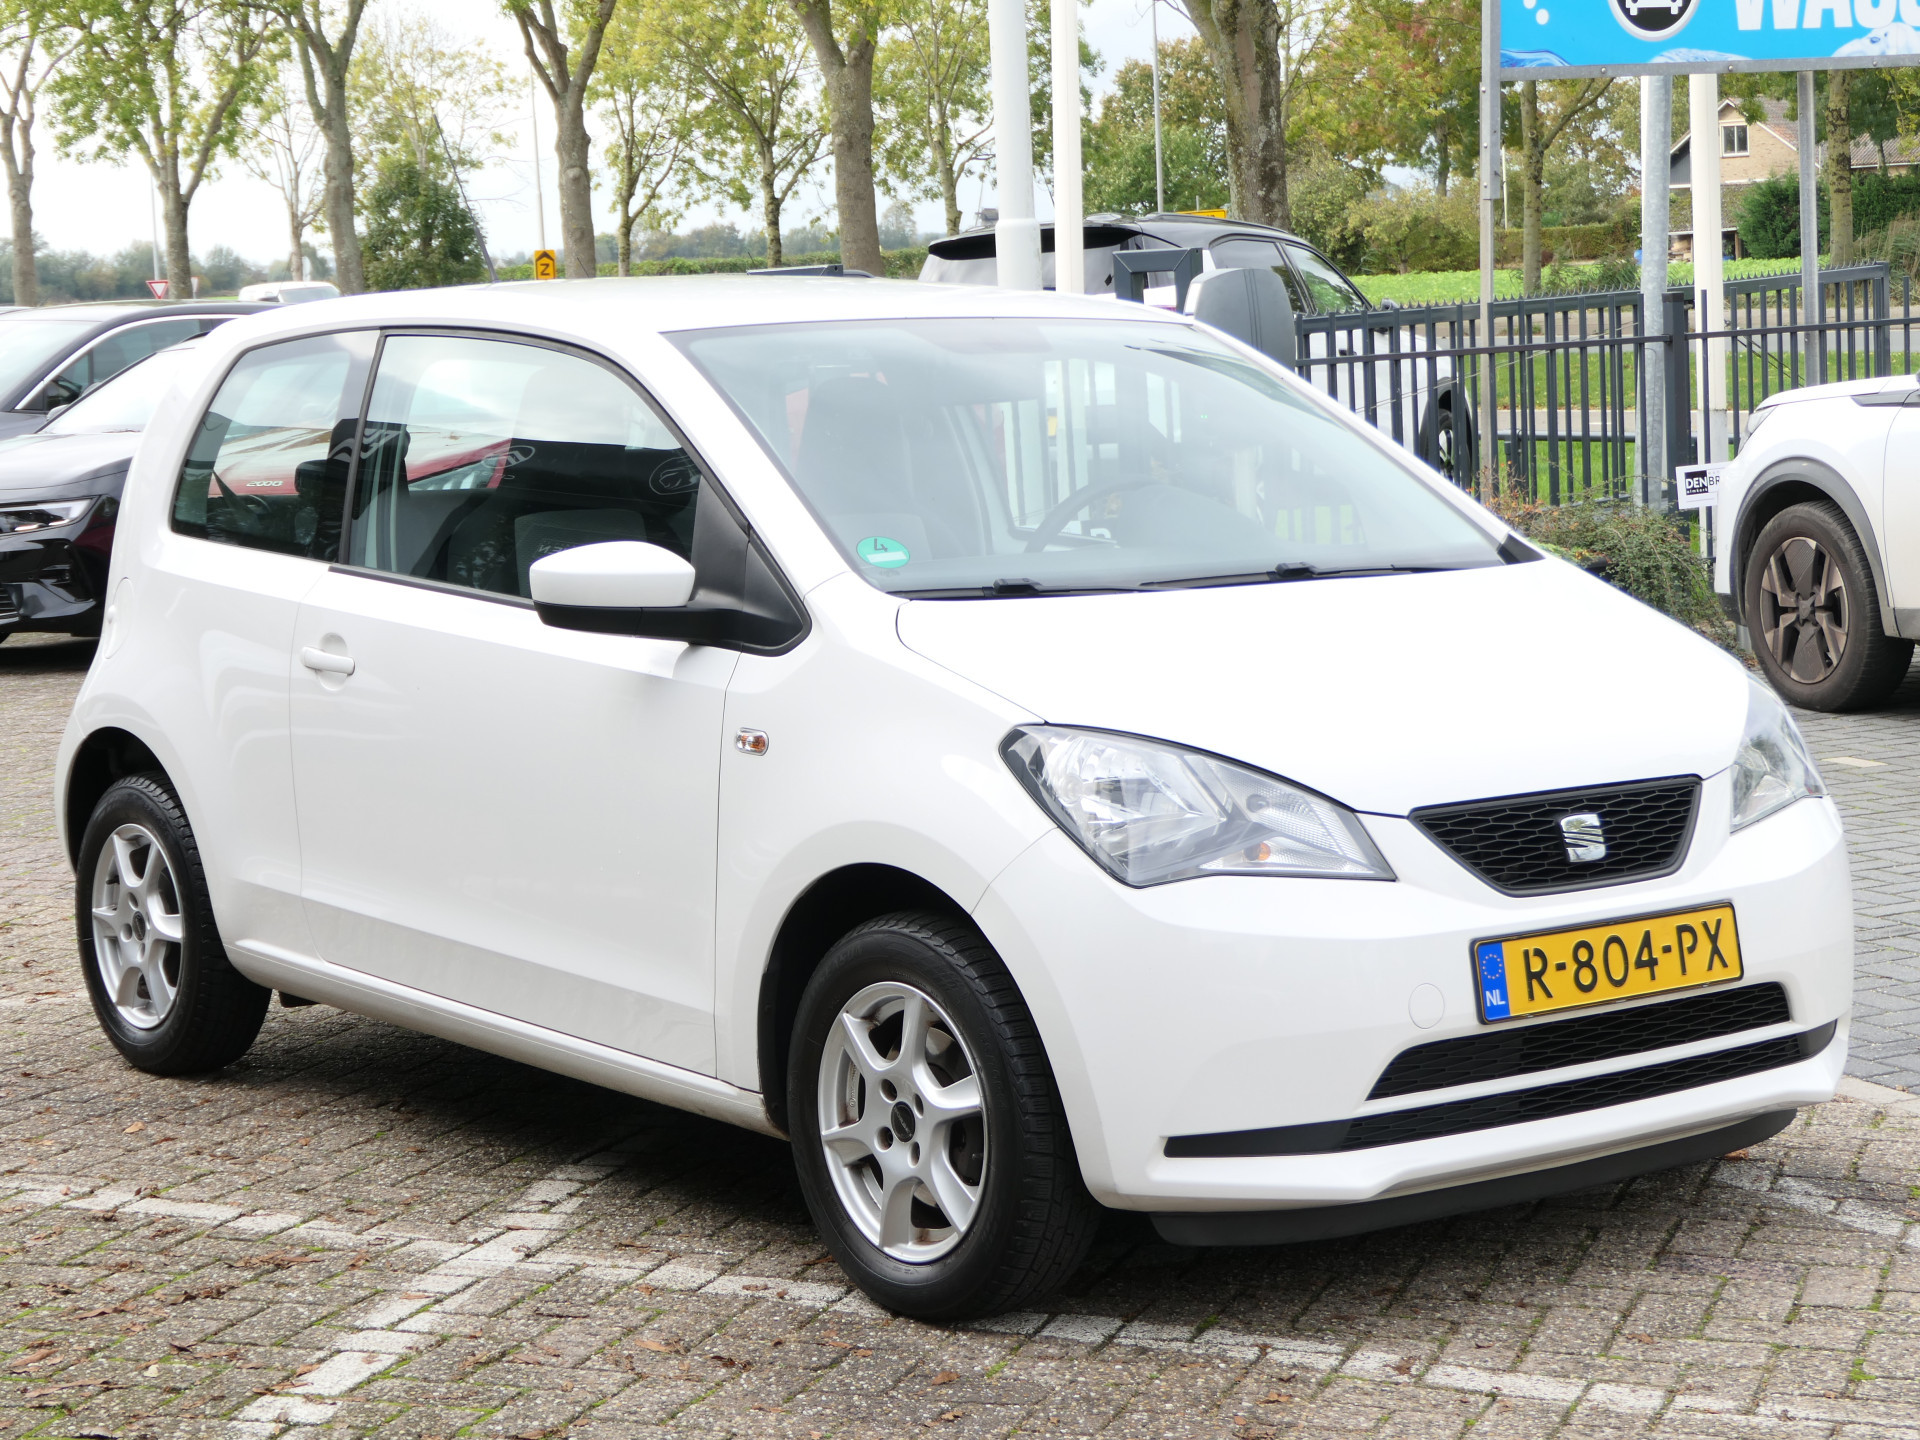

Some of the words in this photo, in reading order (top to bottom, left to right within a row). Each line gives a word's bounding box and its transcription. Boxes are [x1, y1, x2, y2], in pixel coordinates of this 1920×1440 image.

[1685, 476, 1708, 489] DEN
[1522, 918, 1729, 1002] R-804-PX
[1485, 989, 1506, 1007] NL
